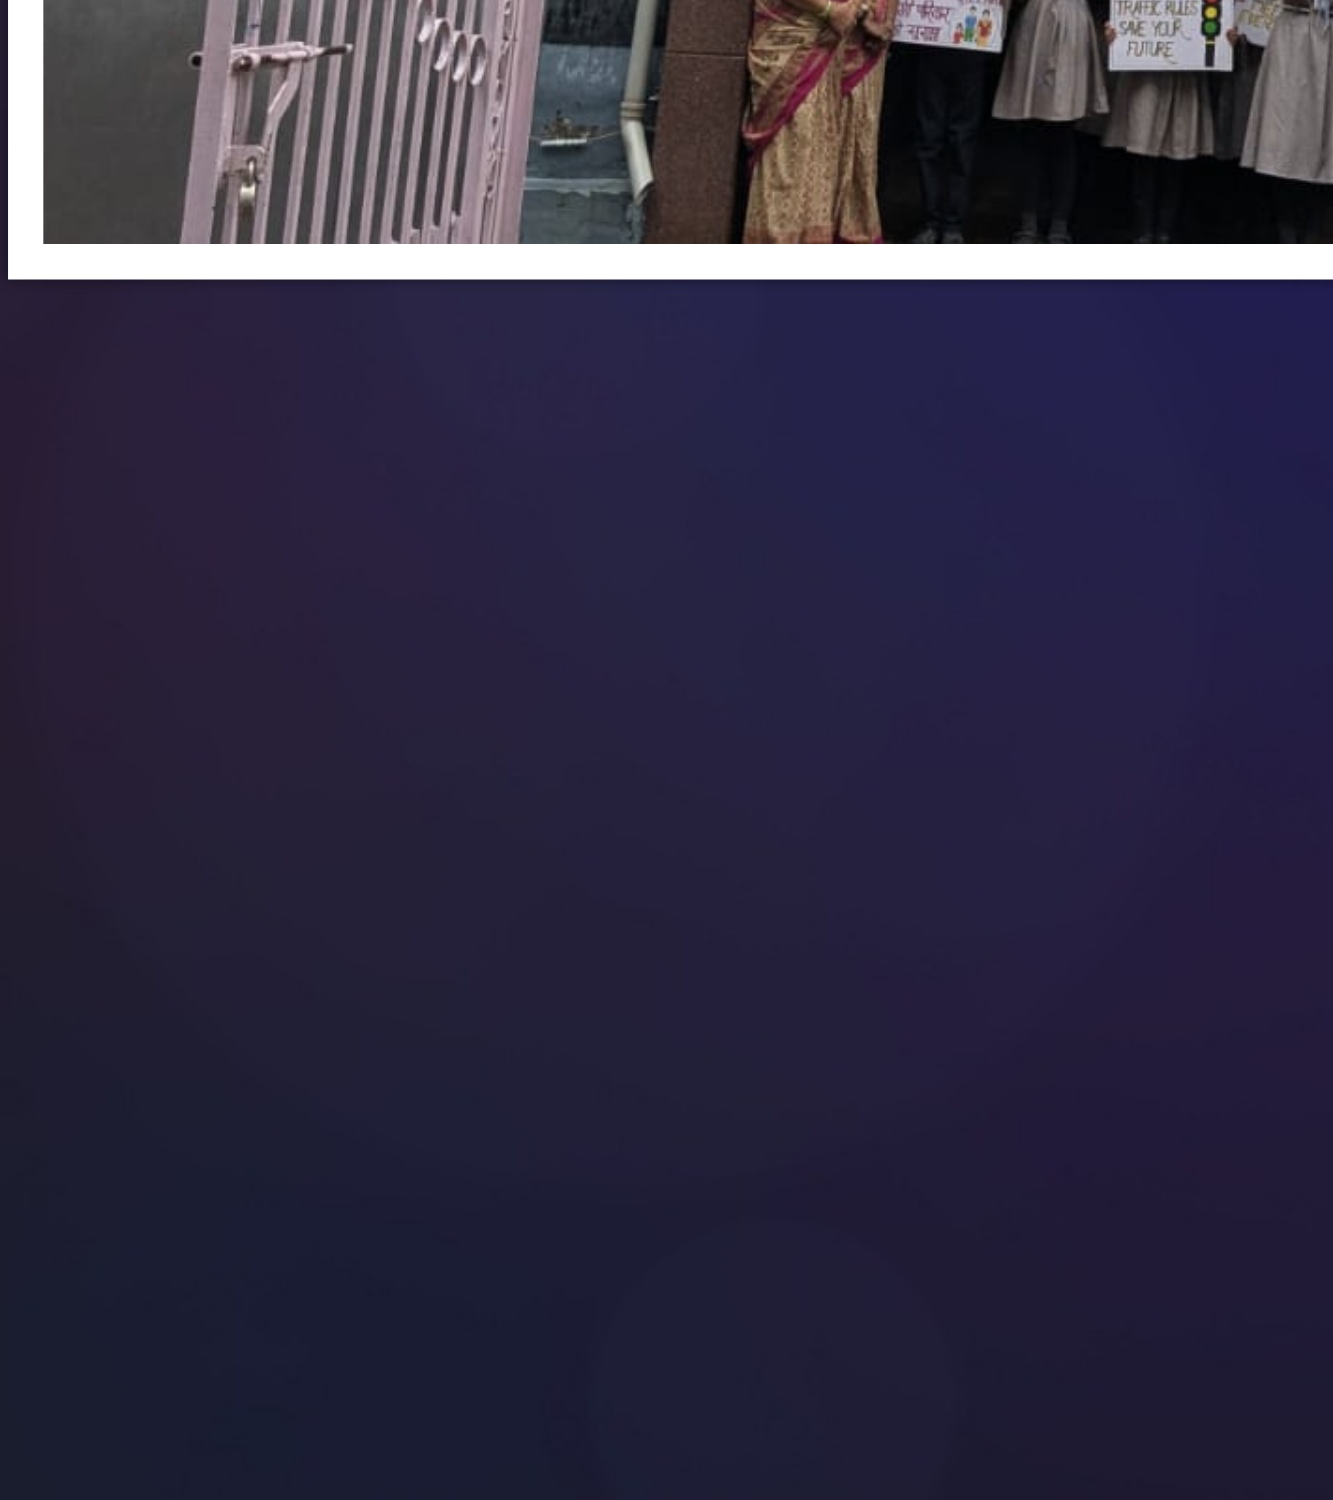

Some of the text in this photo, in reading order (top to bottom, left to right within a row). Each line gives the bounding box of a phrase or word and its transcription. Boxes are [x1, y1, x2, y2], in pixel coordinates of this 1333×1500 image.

[1115, 0, 1198, 17] TRAFFIC RULES
[1118, 20, 1192, 40] SAVE YOUR
[1126, 41, 1178, 64] FUTURE
